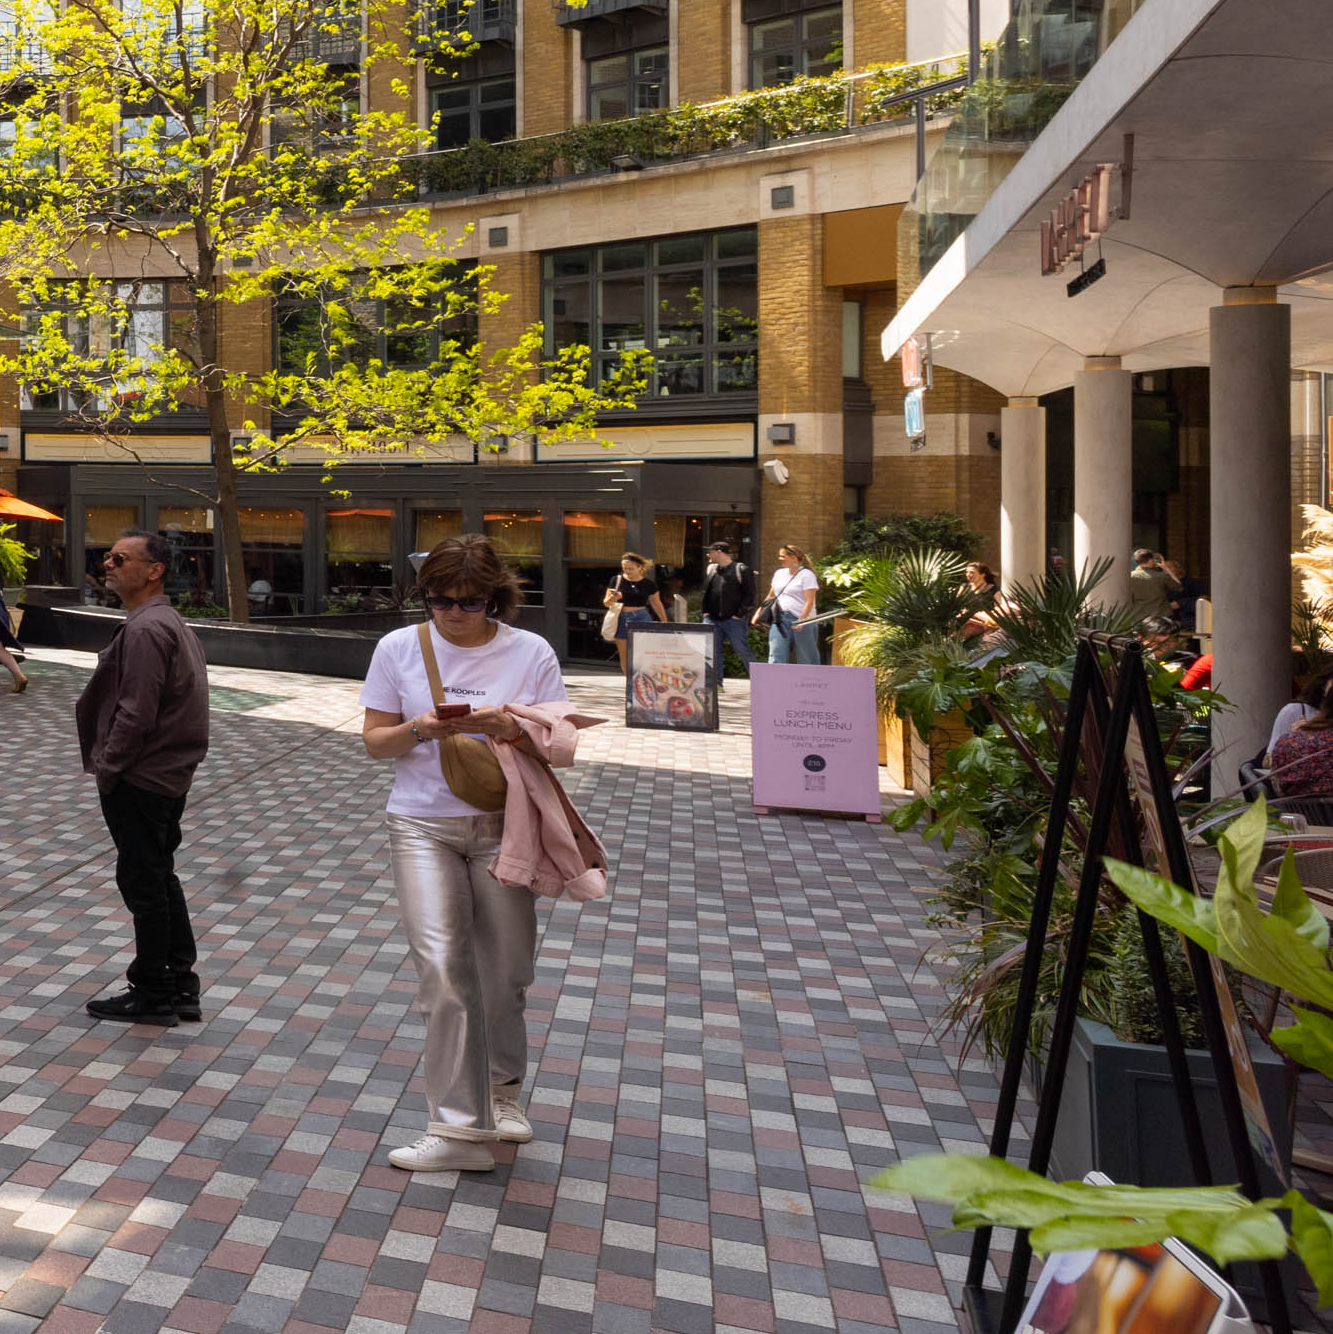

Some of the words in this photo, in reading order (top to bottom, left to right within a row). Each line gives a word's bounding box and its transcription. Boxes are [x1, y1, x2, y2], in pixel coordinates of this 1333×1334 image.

[451, 687, 486, 696] KOOPLES
[785, 709, 839, 721] EXPRESS
[773, 718, 813, 729] LUNCH
[817, 721, 852, 731] MENU
[774, 733, 808, 741] MONDAY
